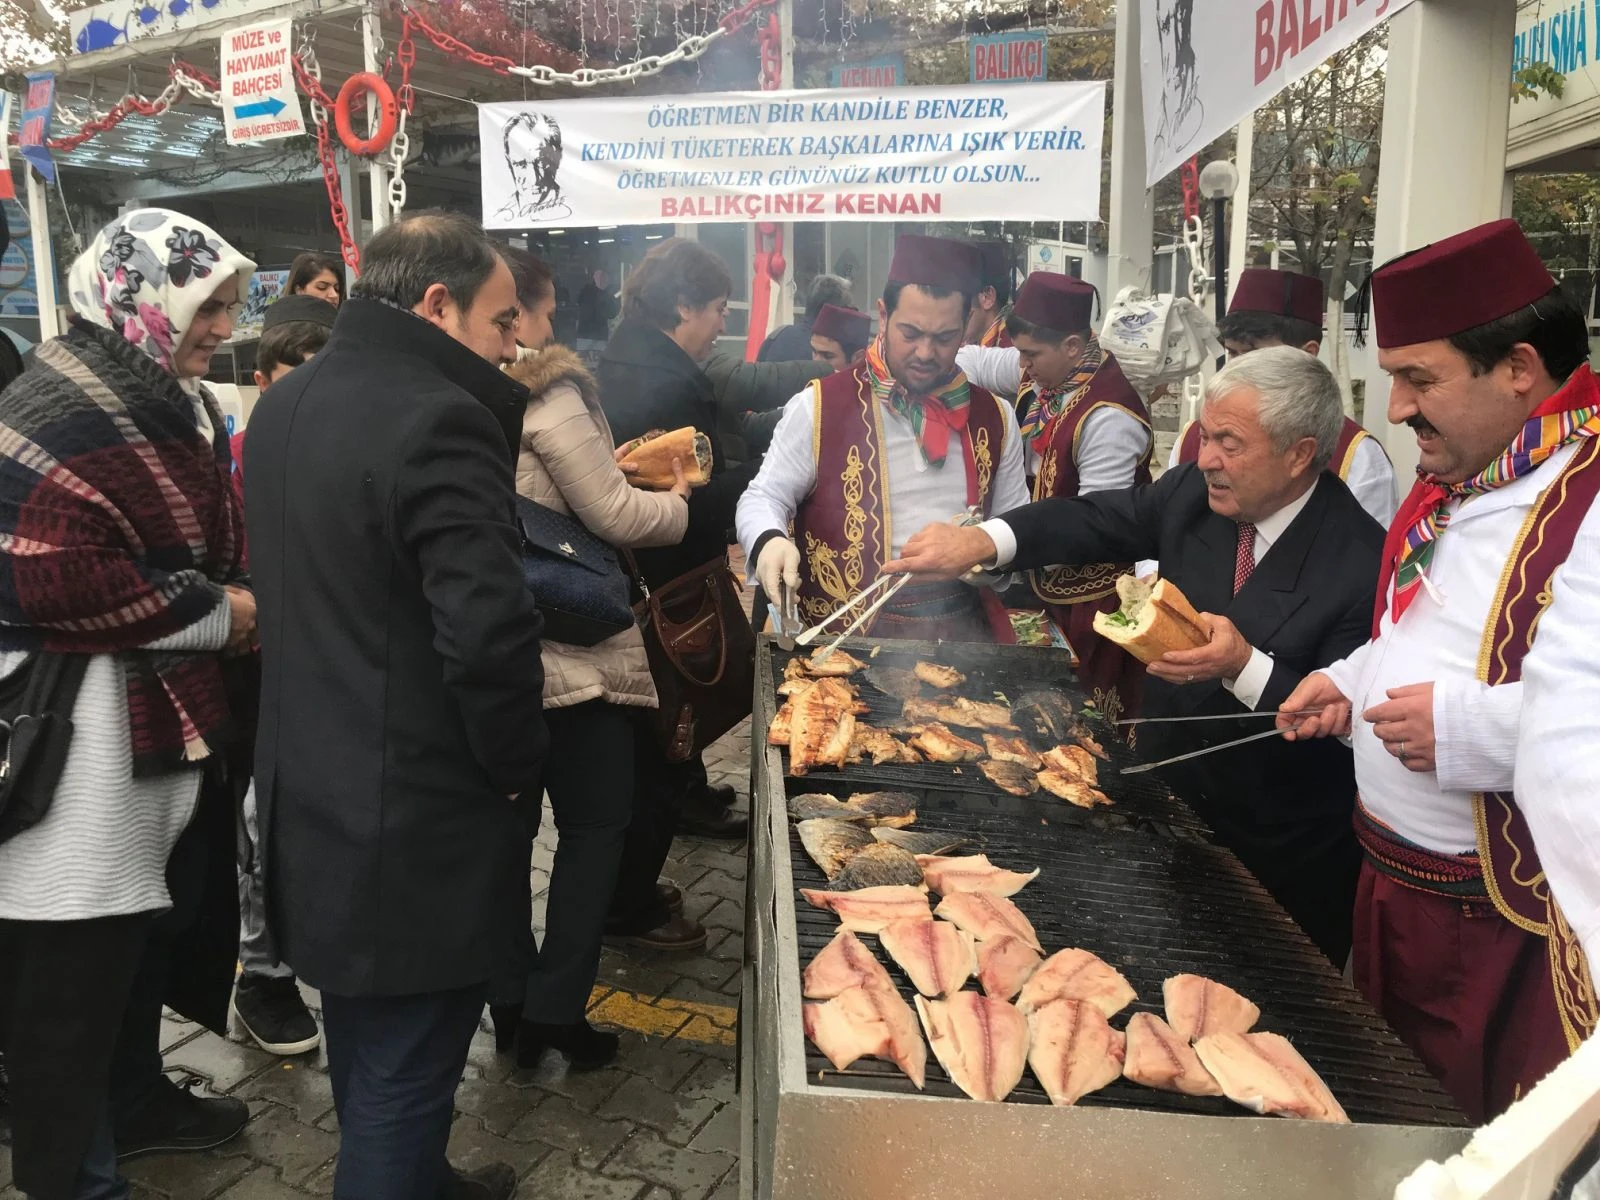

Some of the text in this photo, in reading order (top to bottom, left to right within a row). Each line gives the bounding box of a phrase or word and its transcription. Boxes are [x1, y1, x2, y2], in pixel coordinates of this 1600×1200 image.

[232, 30, 282, 52] MÜZE ve
[226, 48, 287, 76] HAYVANAT
[974, 39, 1043, 82] BALIKÇI
[232, 68, 283, 97] BAHÇESİ
[647, 96, 1009, 129] ÖĞRETMEN BİR KANDİLE BENZER,
[232, 117, 301, 139] GİRİŞ ÜCRETSİZDİR
[580, 125, 1087, 162] KENDİNİ TÜKETEREK BAŞKALARINA IŞIK VERİR.
[616, 164, 1041, 190] ÖĞRETMENLER GÜNÜNÜZ KUTLU OLSUN...
[660, 192, 942, 219] BALIKÇINIZ KENAN
